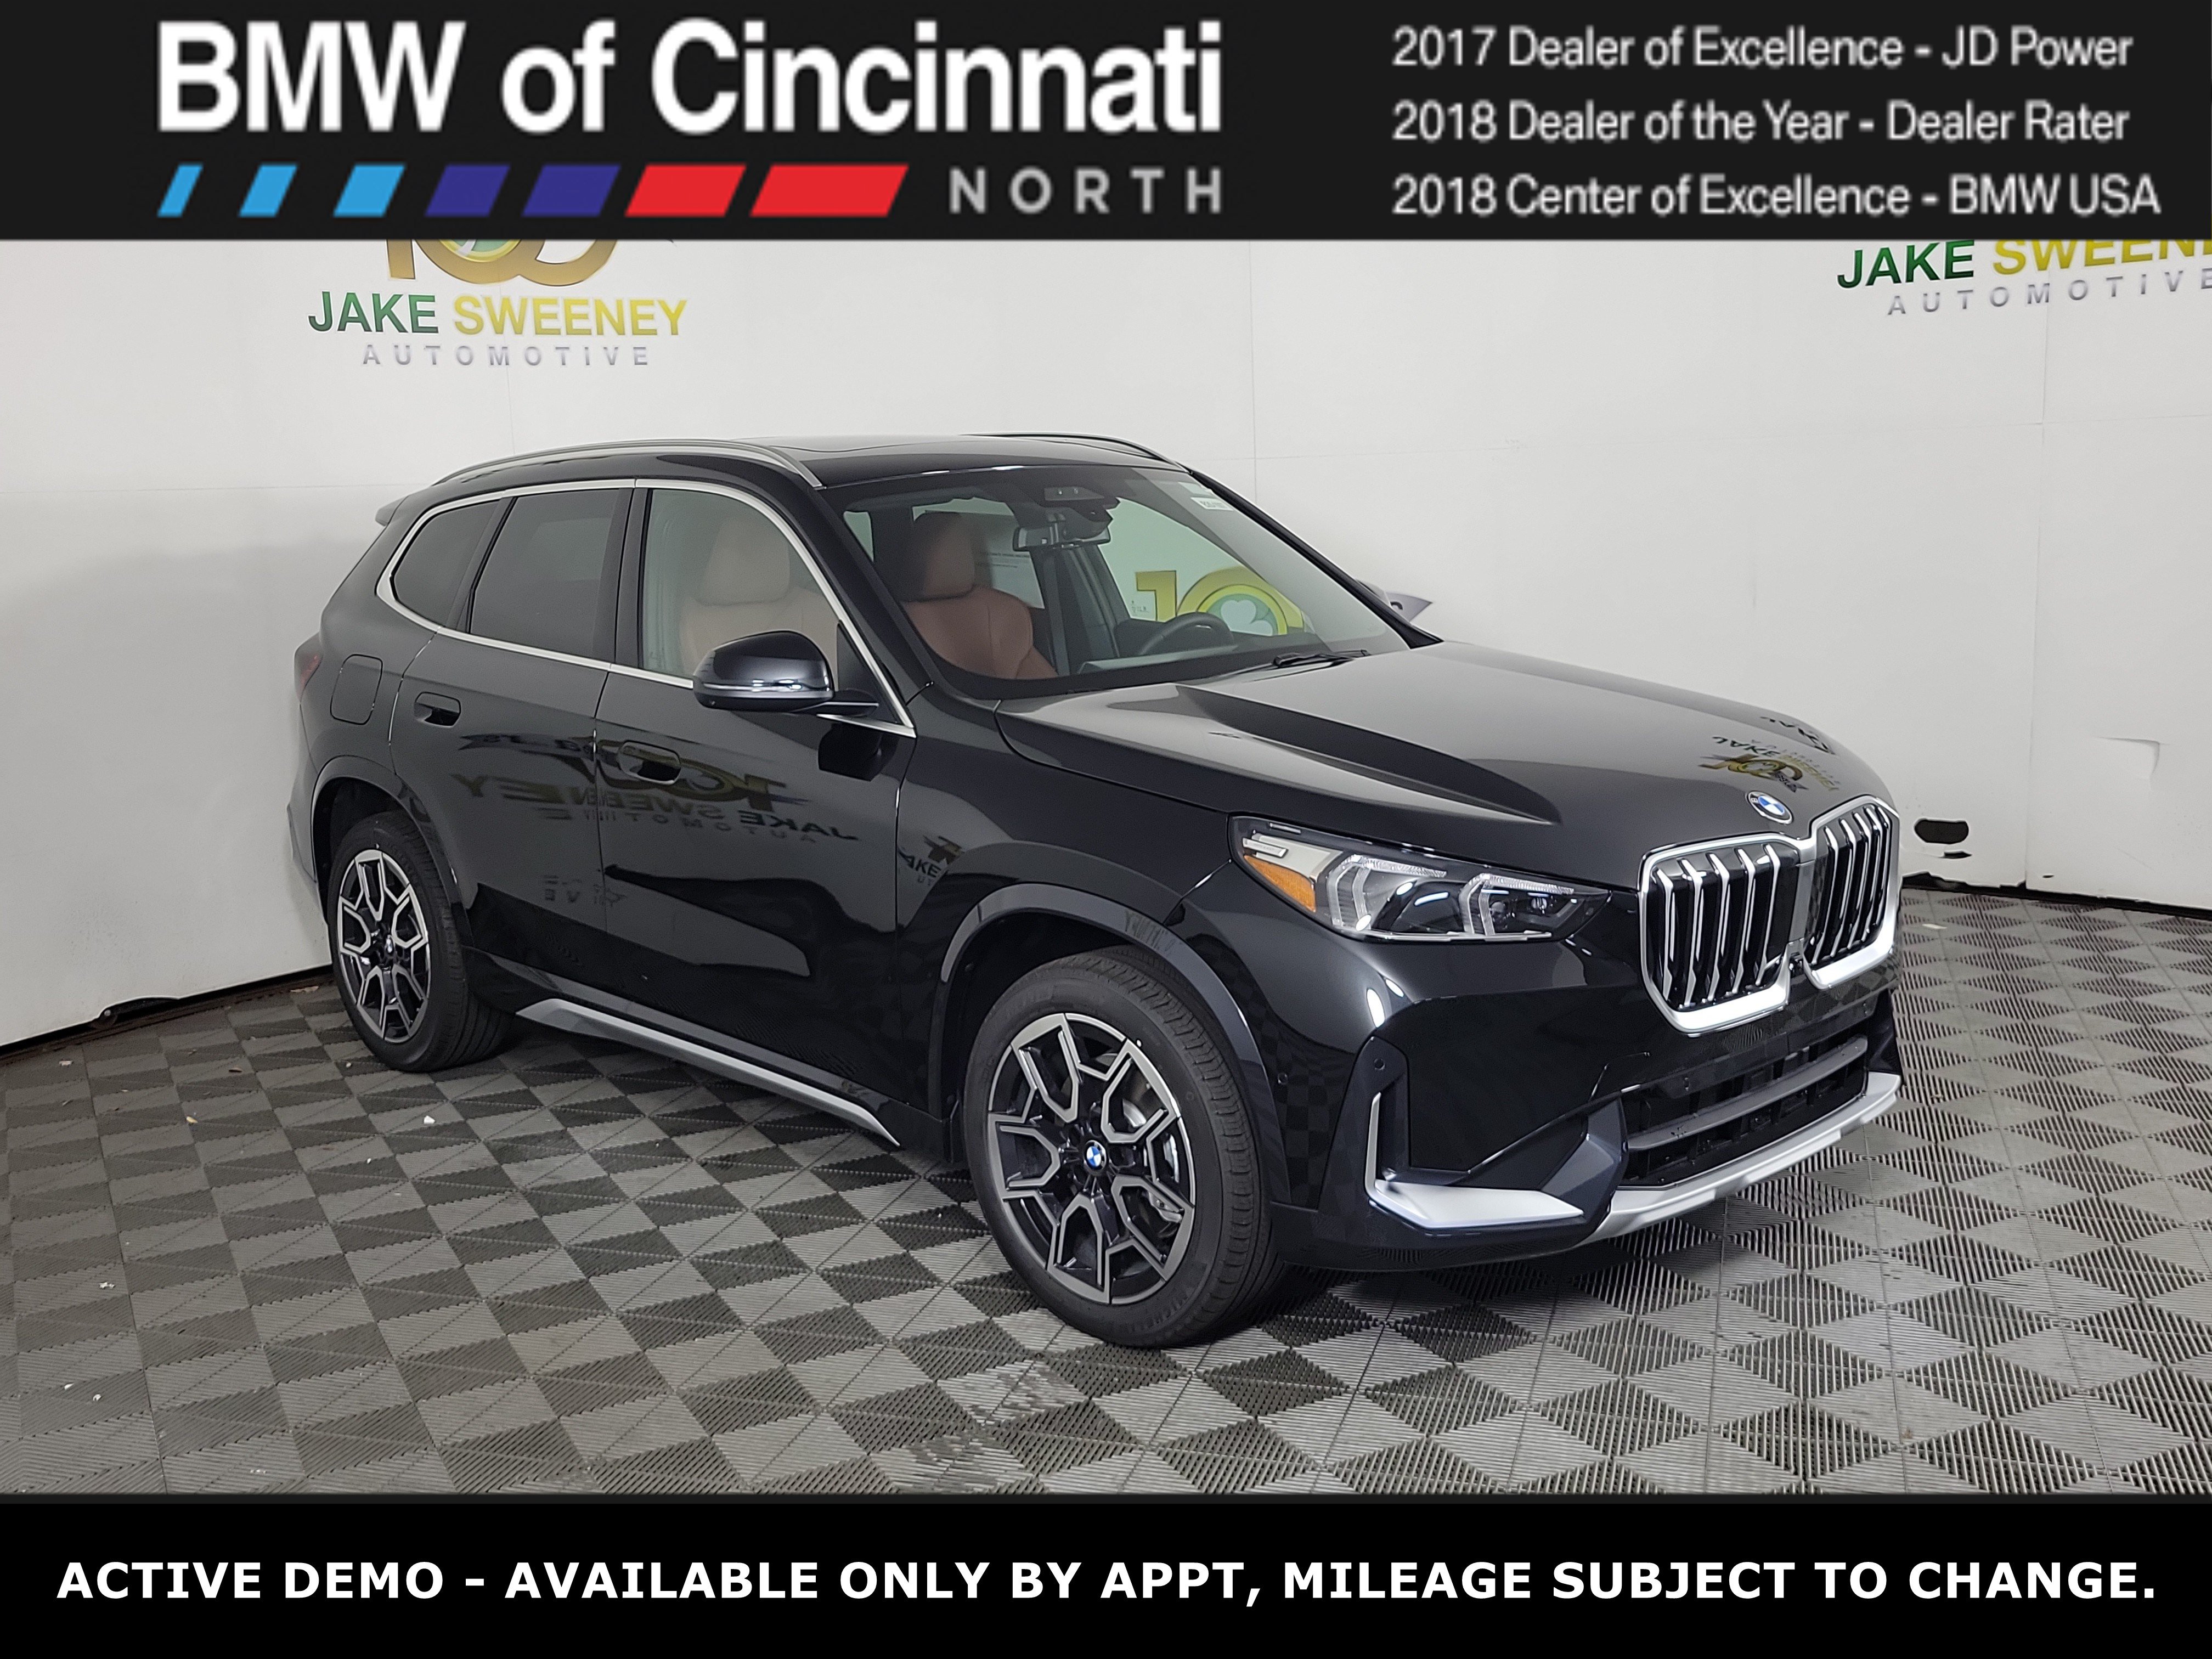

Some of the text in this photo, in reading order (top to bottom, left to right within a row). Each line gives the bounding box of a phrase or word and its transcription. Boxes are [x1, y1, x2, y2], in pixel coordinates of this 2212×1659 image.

[1837, 240, 1974, 289] JAKE
[307, 290, 688, 336] JAKE SWEENEY
[1887, 272, 2212, 315] AUTOMOTIVE
[362, 343, 650, 367] AUTOMOTIVE
